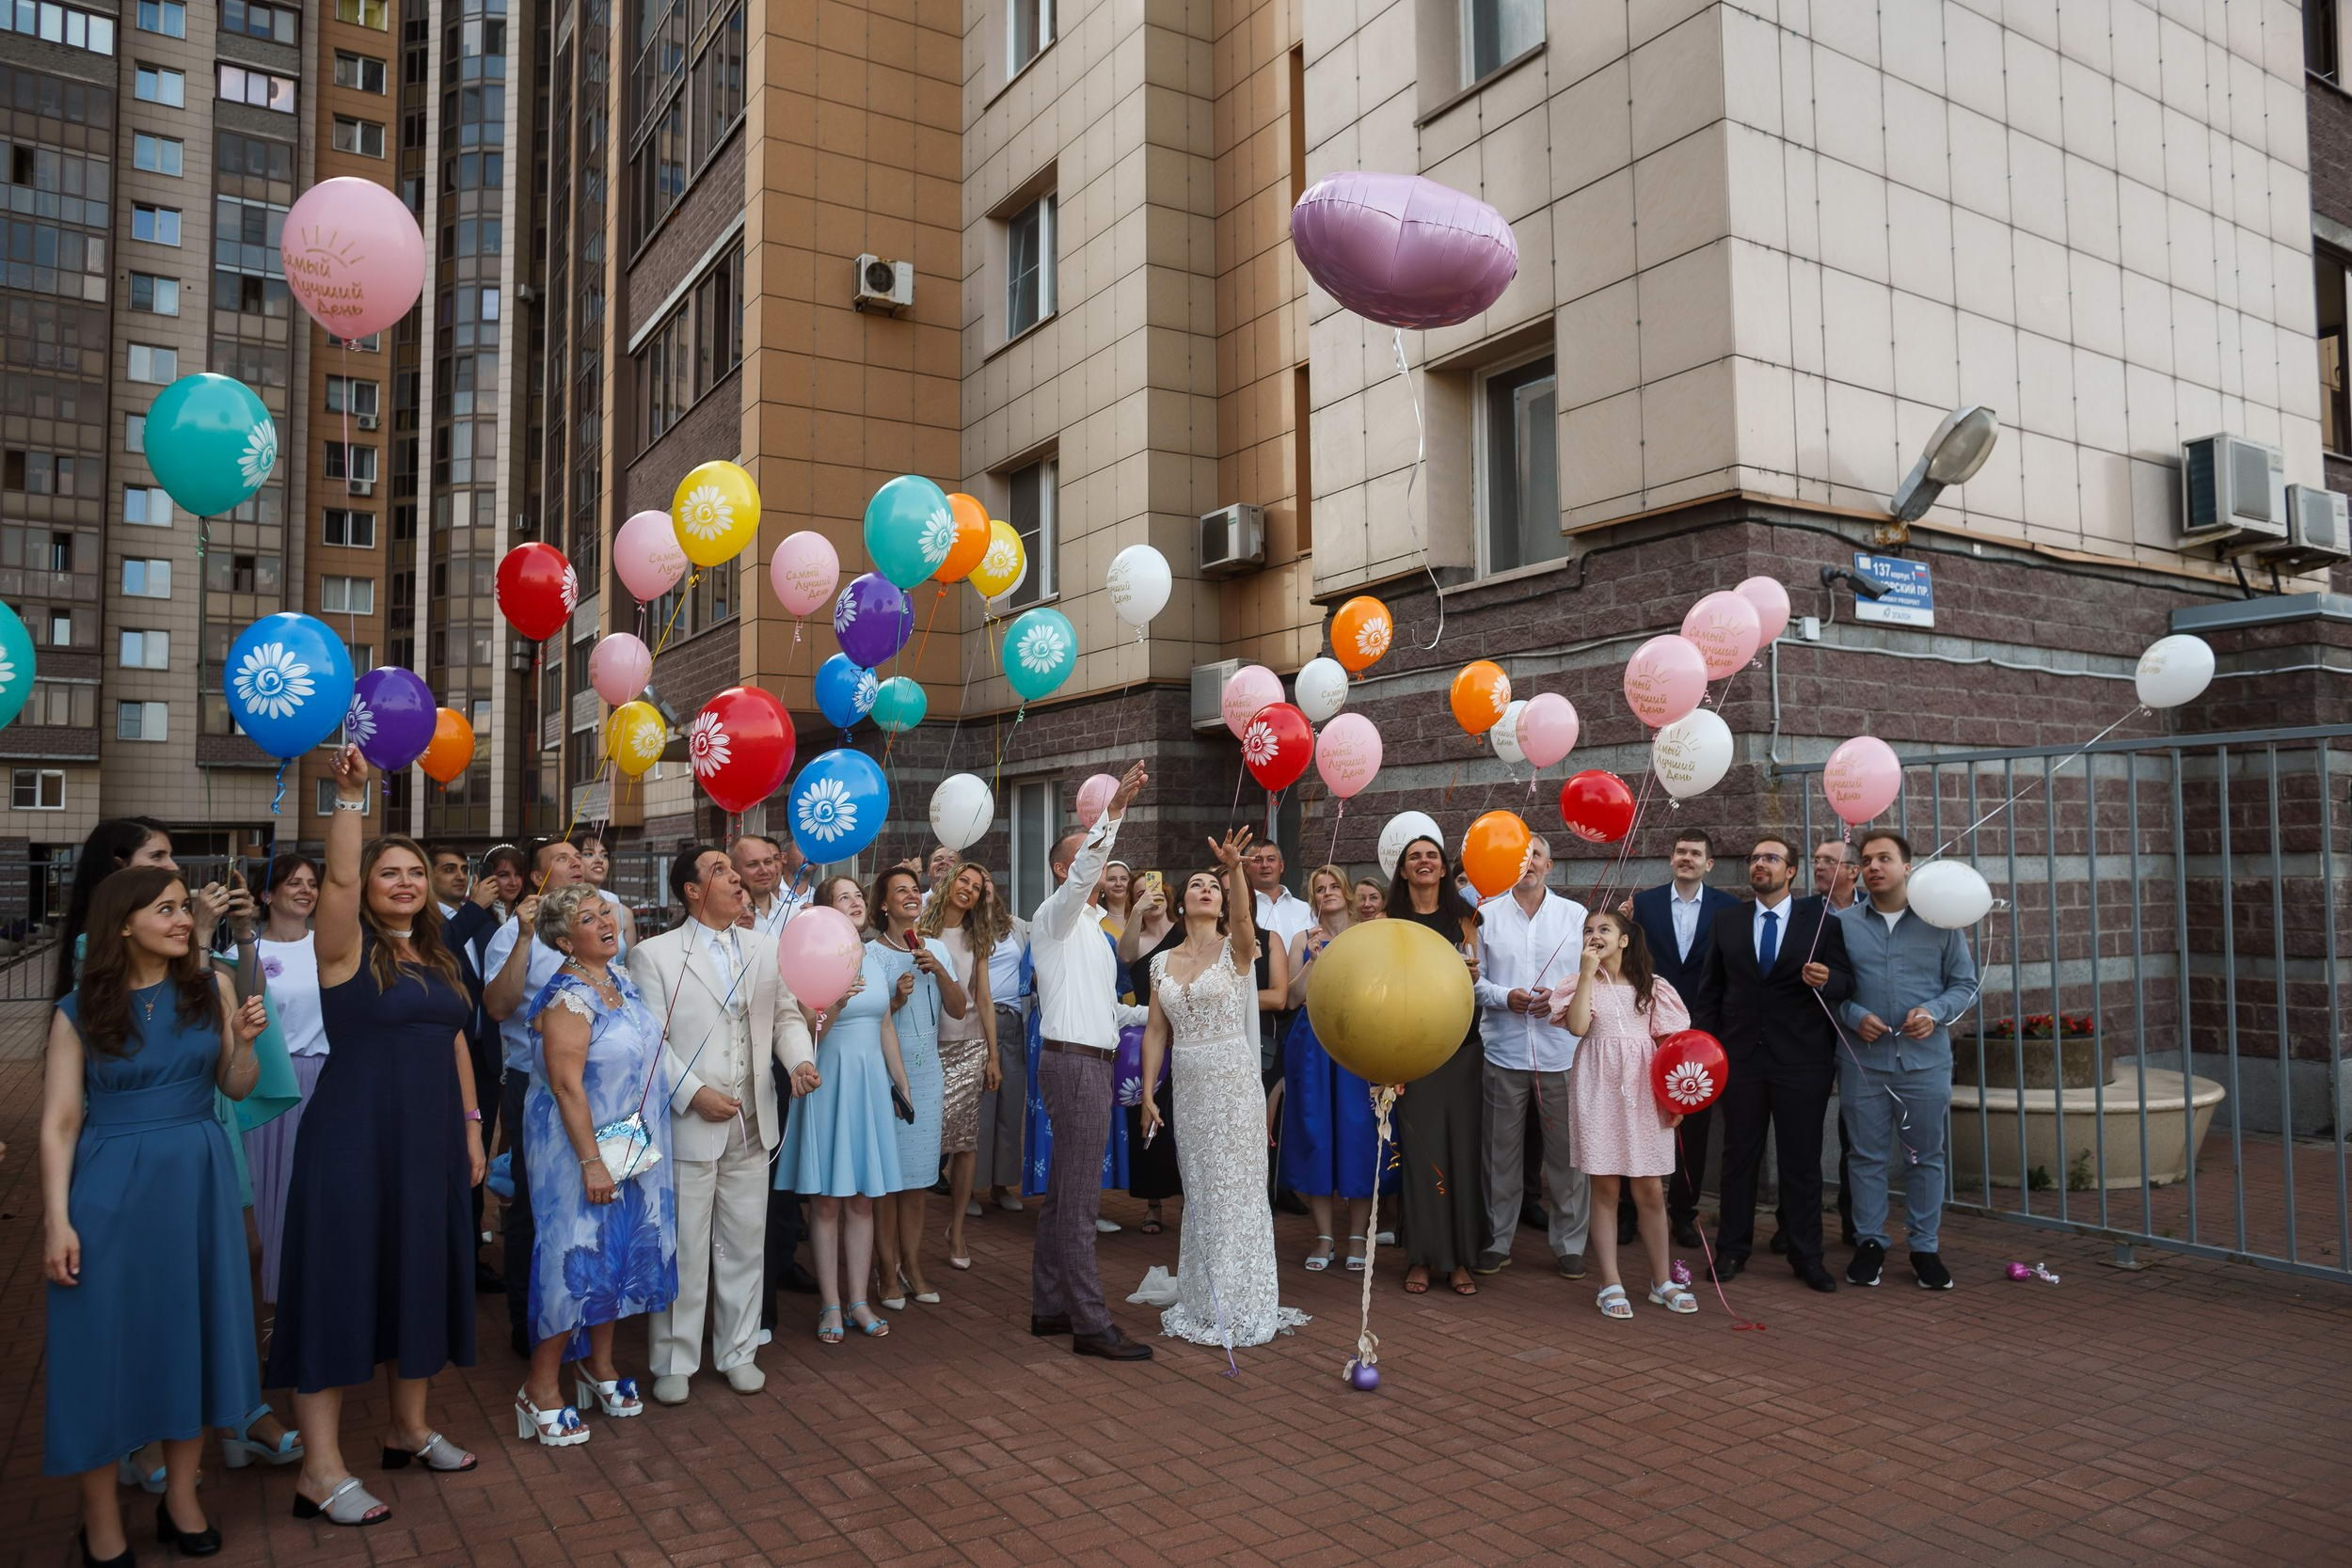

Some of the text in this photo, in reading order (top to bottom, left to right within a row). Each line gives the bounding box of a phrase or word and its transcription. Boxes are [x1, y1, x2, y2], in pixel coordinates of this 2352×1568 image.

[292, 272, 363, 300] Лучший
[316, 298, 363, 318] День
[787, 566, 819, 580] Самый
[1873, 562, 1916, 581] 137 корпус 1
[795, 576, 832, 592] Лучший
[1917, 585, 1929, 597] ПР.
[807, 589, 829, 601] День
[1689, 626, 1726, 643] Самый
[1695, 641, 1740, 657] Лучший
[1706, 656, 1733, 669] День
[1224, 697, 1251, 708] Самый
[1628, 689, 1668, 705] Лучший
[1640, 703, 1666, 715] День
[1322, 745, 1353, 759] Самый
[1328, 753, 1367, 771] Лучший
[1656, 754, 1696, 771] Лучший
[1342, 768, 1366, 781] День
[1666, 769, 1692, 783] День
[1826, 777, 1863, 792] Лучший
[1836, 789, 1861, 803] День
